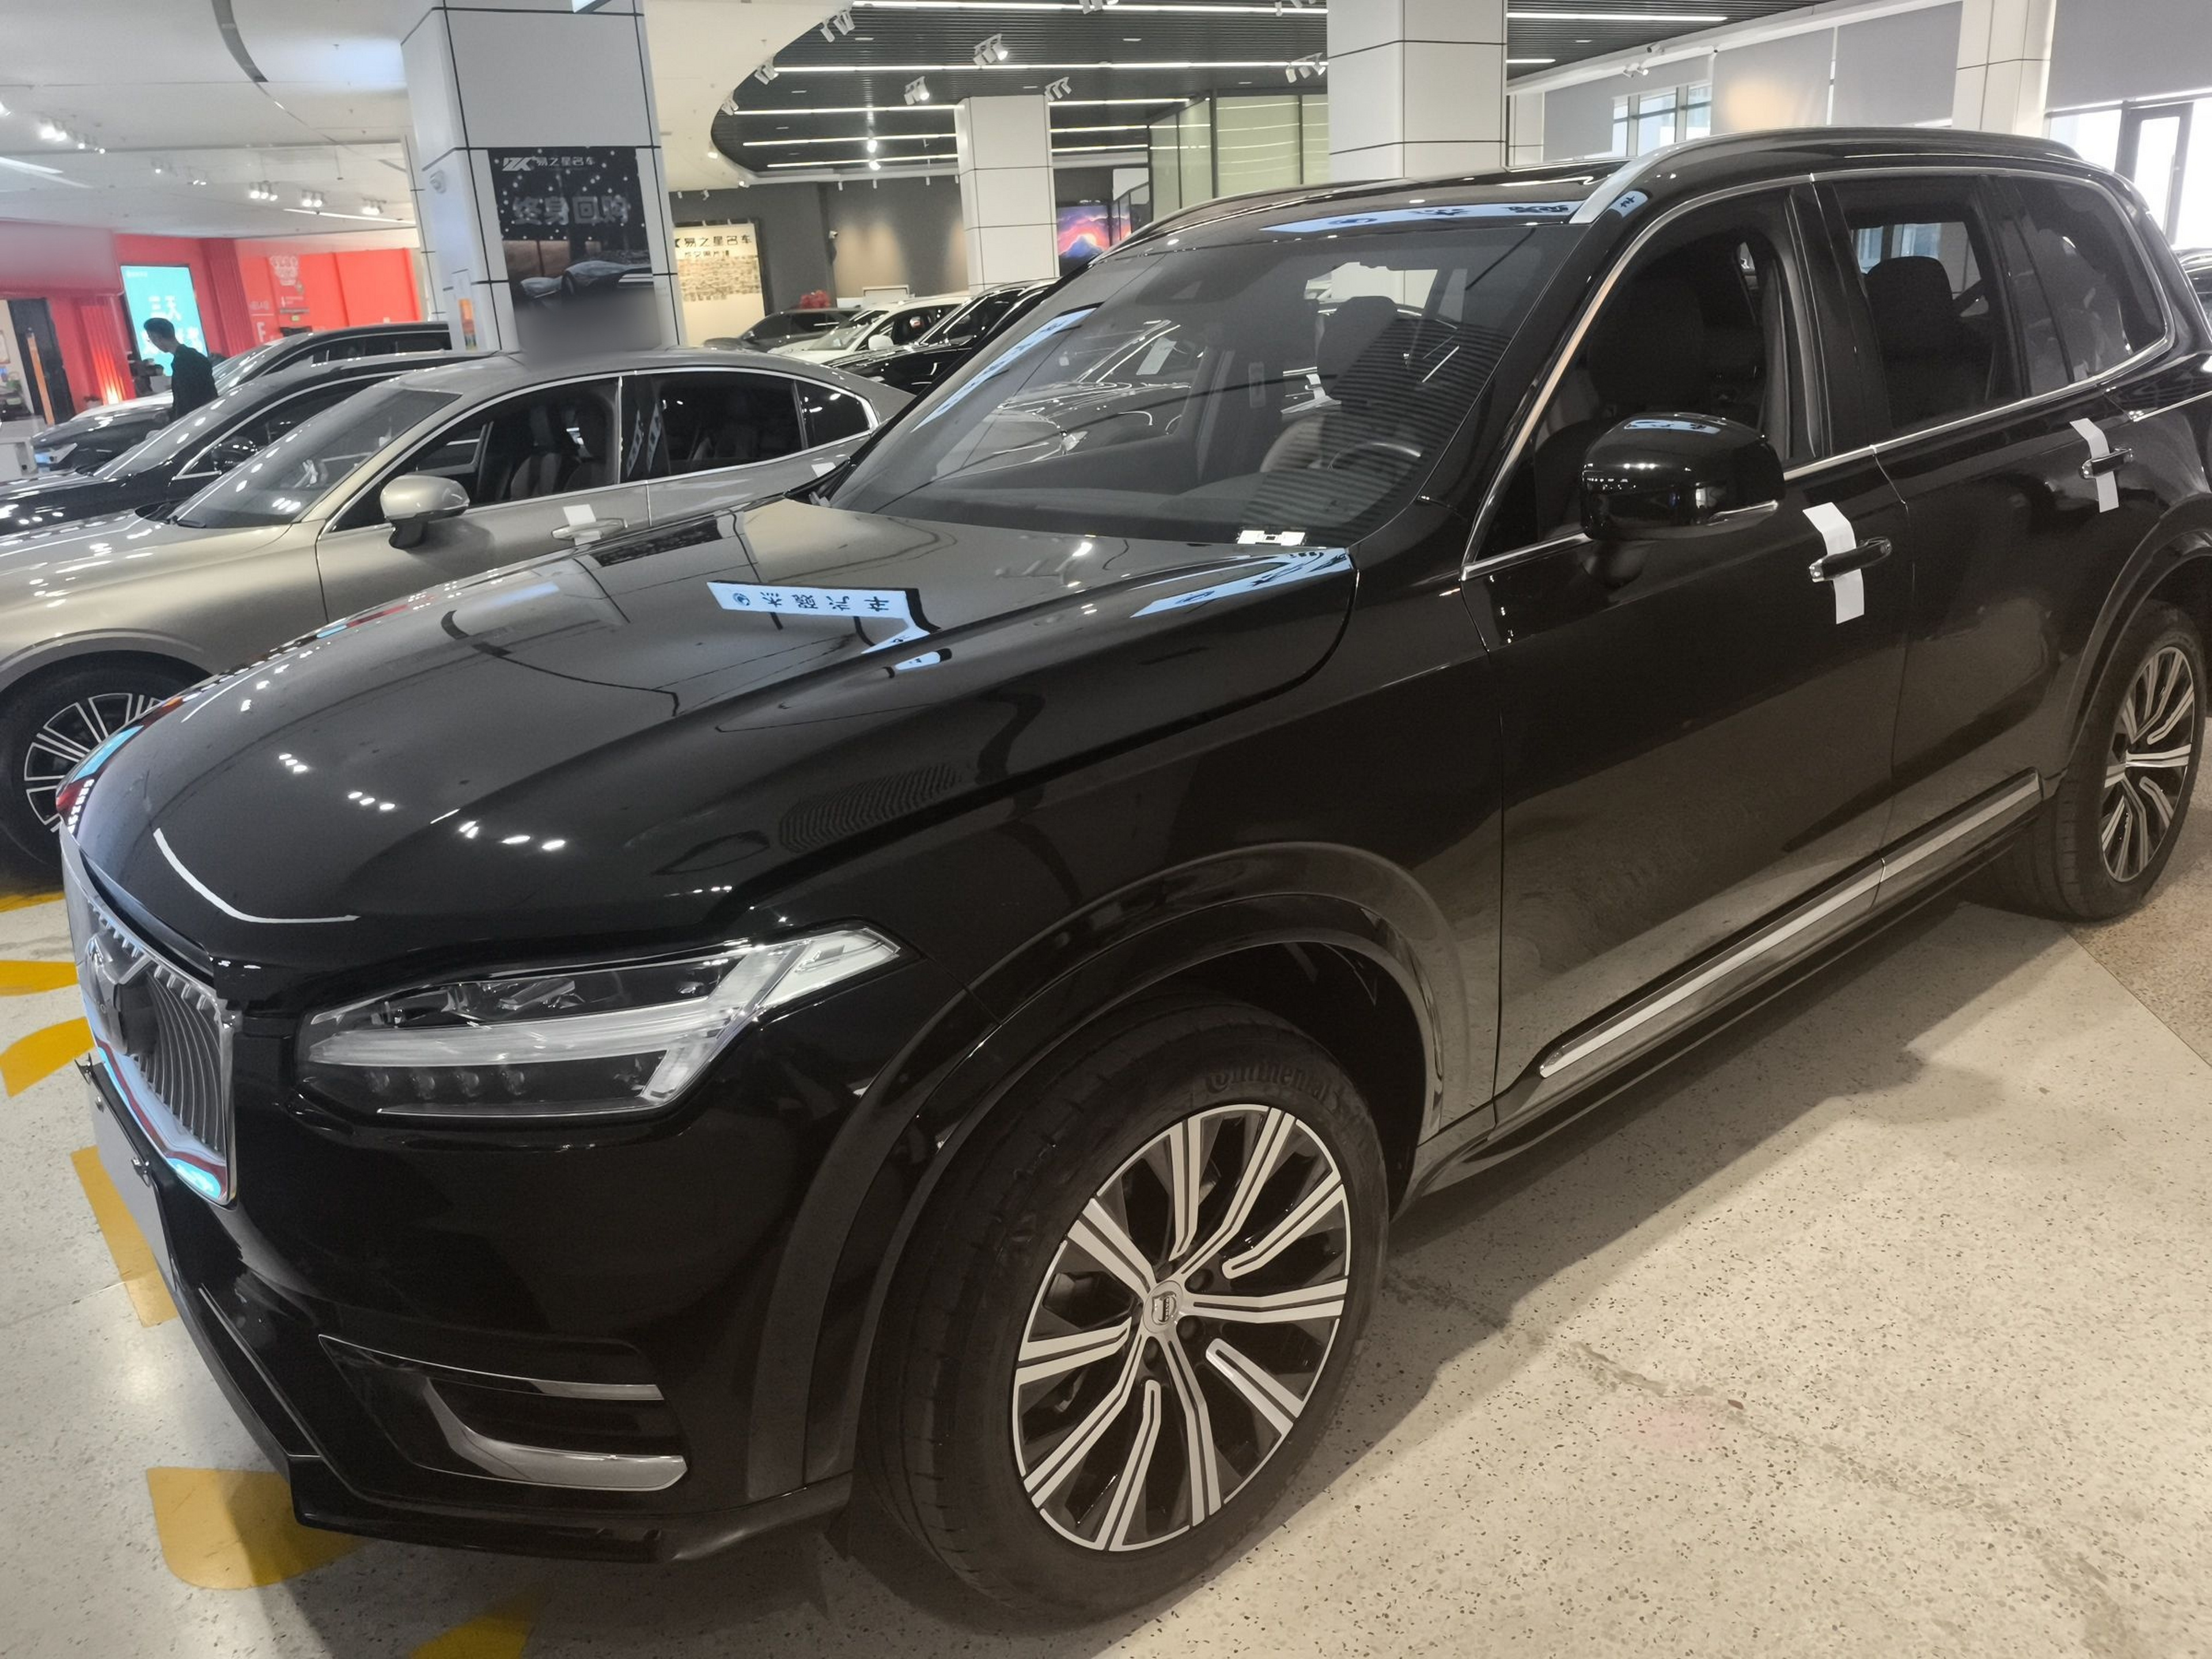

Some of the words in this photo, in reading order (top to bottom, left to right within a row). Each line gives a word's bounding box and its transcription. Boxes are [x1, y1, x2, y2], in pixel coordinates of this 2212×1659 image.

[513, 196, 628, 225] 终身回购
[684, 234, 752, 247] 易之星名车
